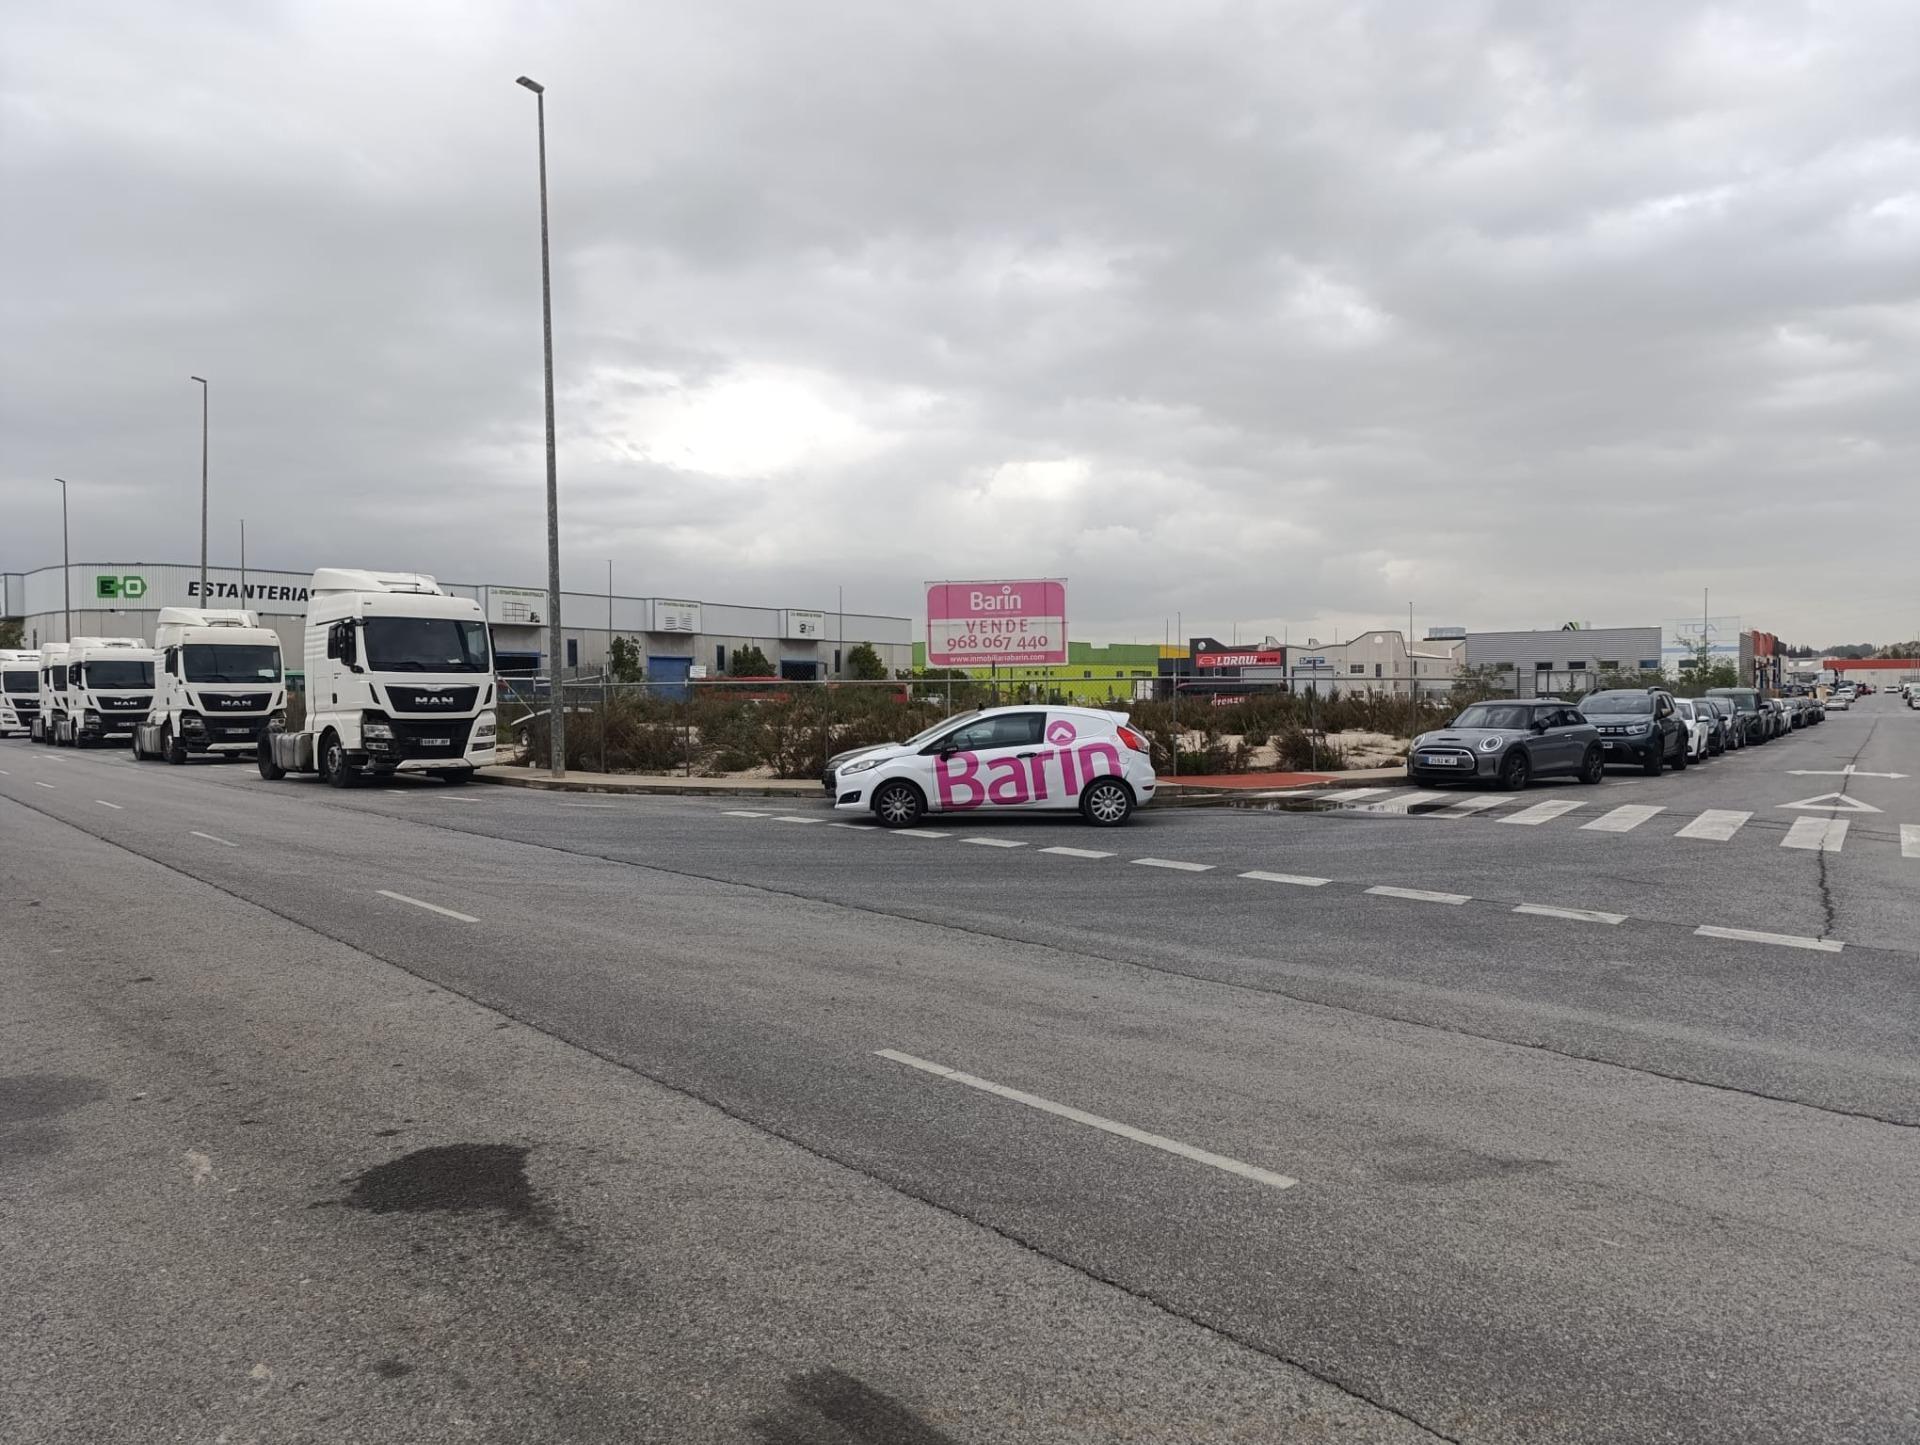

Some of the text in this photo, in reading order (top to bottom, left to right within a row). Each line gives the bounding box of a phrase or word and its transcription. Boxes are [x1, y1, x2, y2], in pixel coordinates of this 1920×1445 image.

[187, 581, 315, 602] ESTANTERIA
[970, 585, 1022, 611] Barin
[966, 618, 1028, 634] VENDE
[947, 634, 1049, 652] 968 067 440
[950, 653, 1046, 663] www.inmobiliariabarin.com
[414, 696, 454, 705] MAN
[934, 720, 1123, 812] Barin
